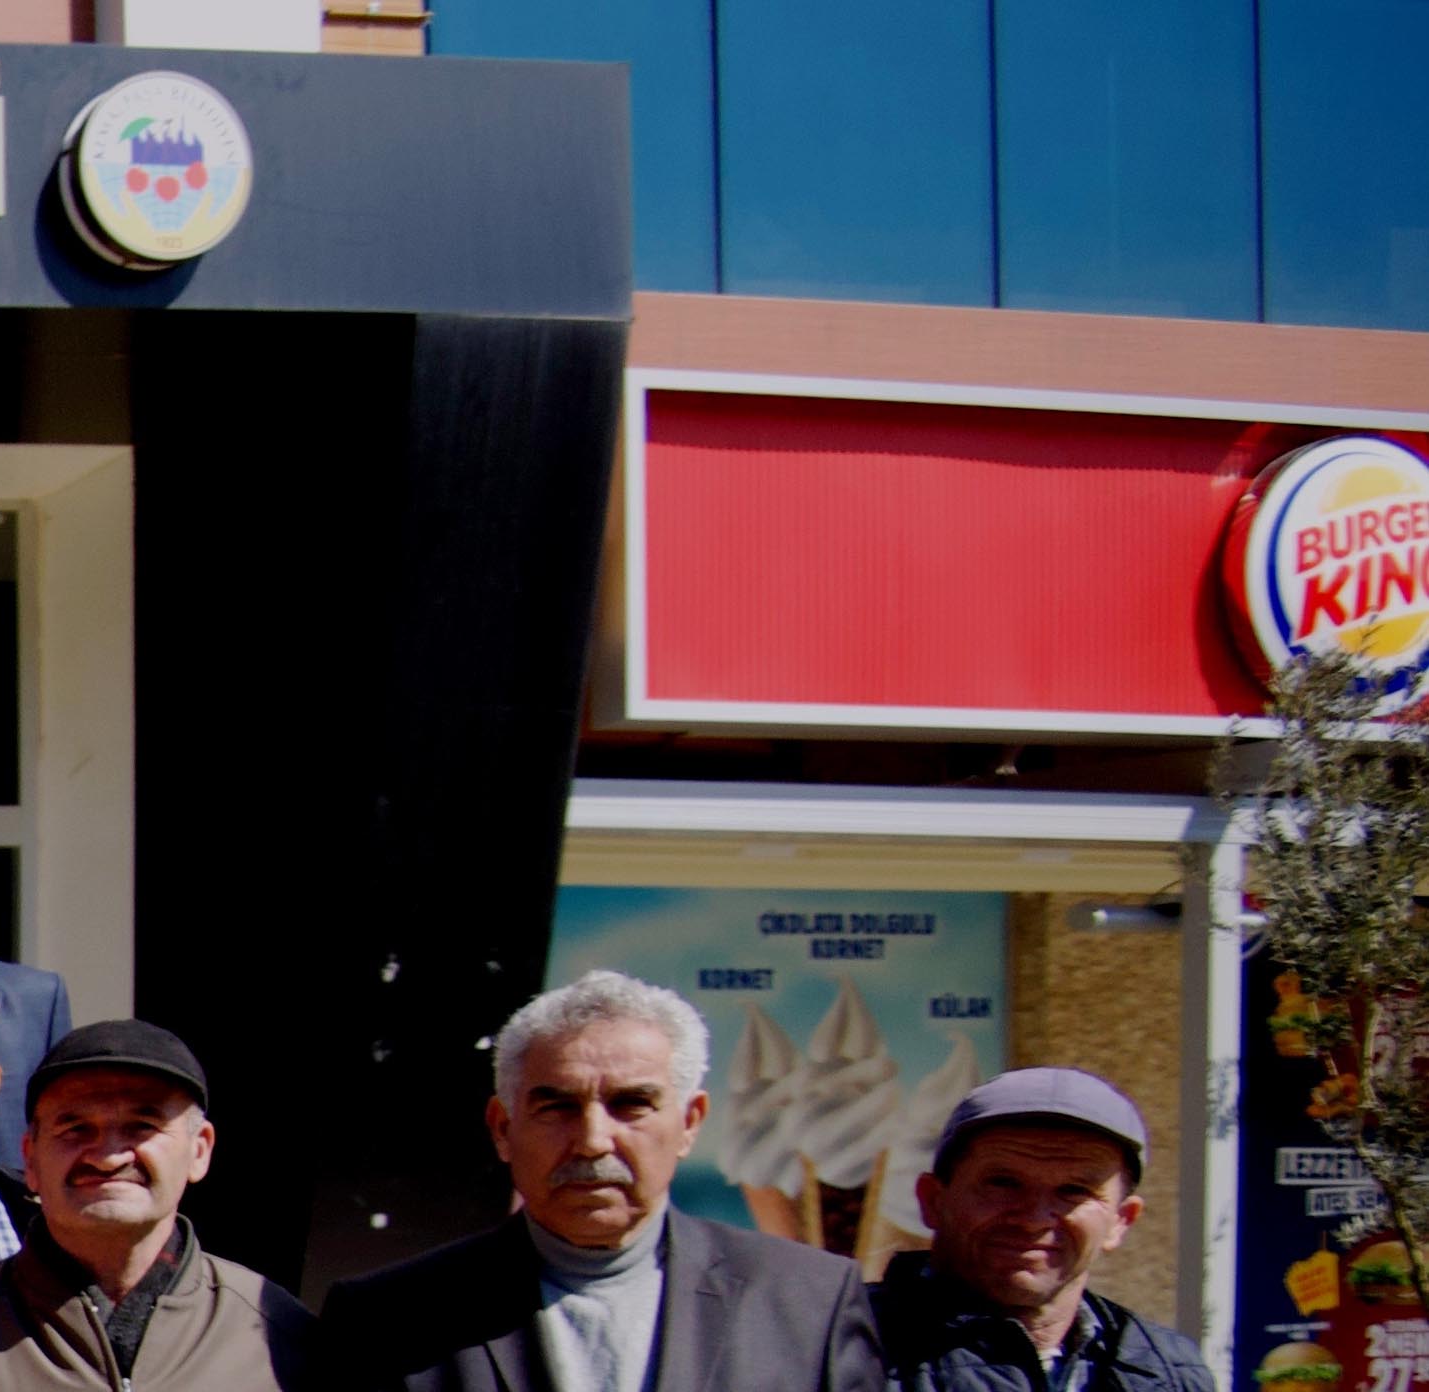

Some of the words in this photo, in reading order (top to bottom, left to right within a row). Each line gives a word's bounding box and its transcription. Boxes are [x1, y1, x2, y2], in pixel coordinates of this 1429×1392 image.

[1295, 501, 1429, 575] BURGE
[1295, 544, 1429, 642] KIN
[809, 938, 885, 960] KORNET
[697, 968, 775, 991] KORNET
